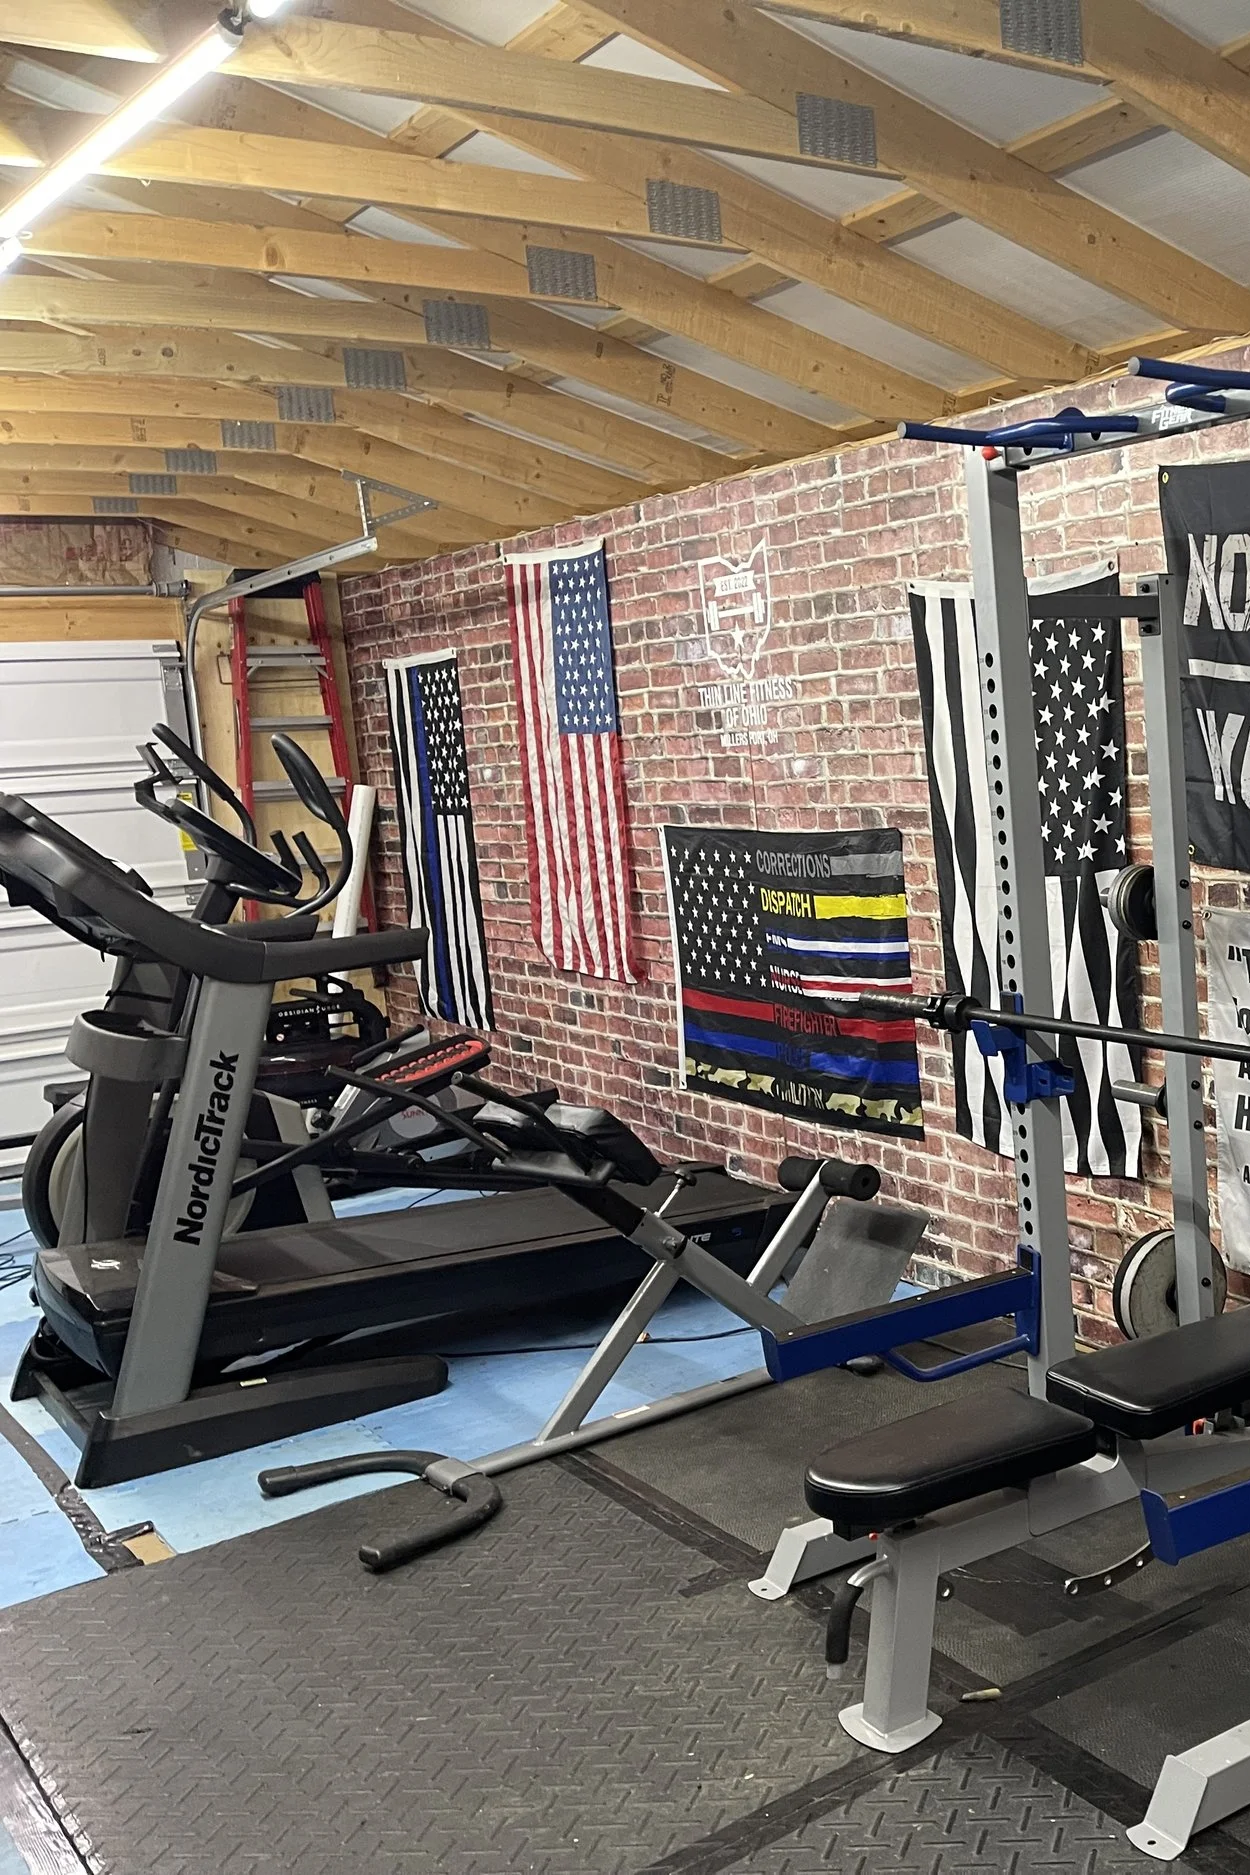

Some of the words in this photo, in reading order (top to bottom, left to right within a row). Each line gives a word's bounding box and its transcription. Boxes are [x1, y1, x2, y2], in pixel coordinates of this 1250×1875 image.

[1159, 411, 1192, 430] GEAR
[698, 685, 721, 708] THIN
[723, 683, 748, 705] LINE
[749, 677, 793, 701] FITNESS
[726, 707, 739, 728] OF
[742, 704, 768, 727] OHIO
[756, 849, 831, 878] CORRECTIONS
[761, 888, 812, 918] DISPATCH
[769, 964, 803, 995] NURSE
[278, 1007, 314, 1017] OBSIDIAN
[774, 1003, 838, 1037] FIREFIGHTER
[173, 1050, 239, 1246] NordicTrack
